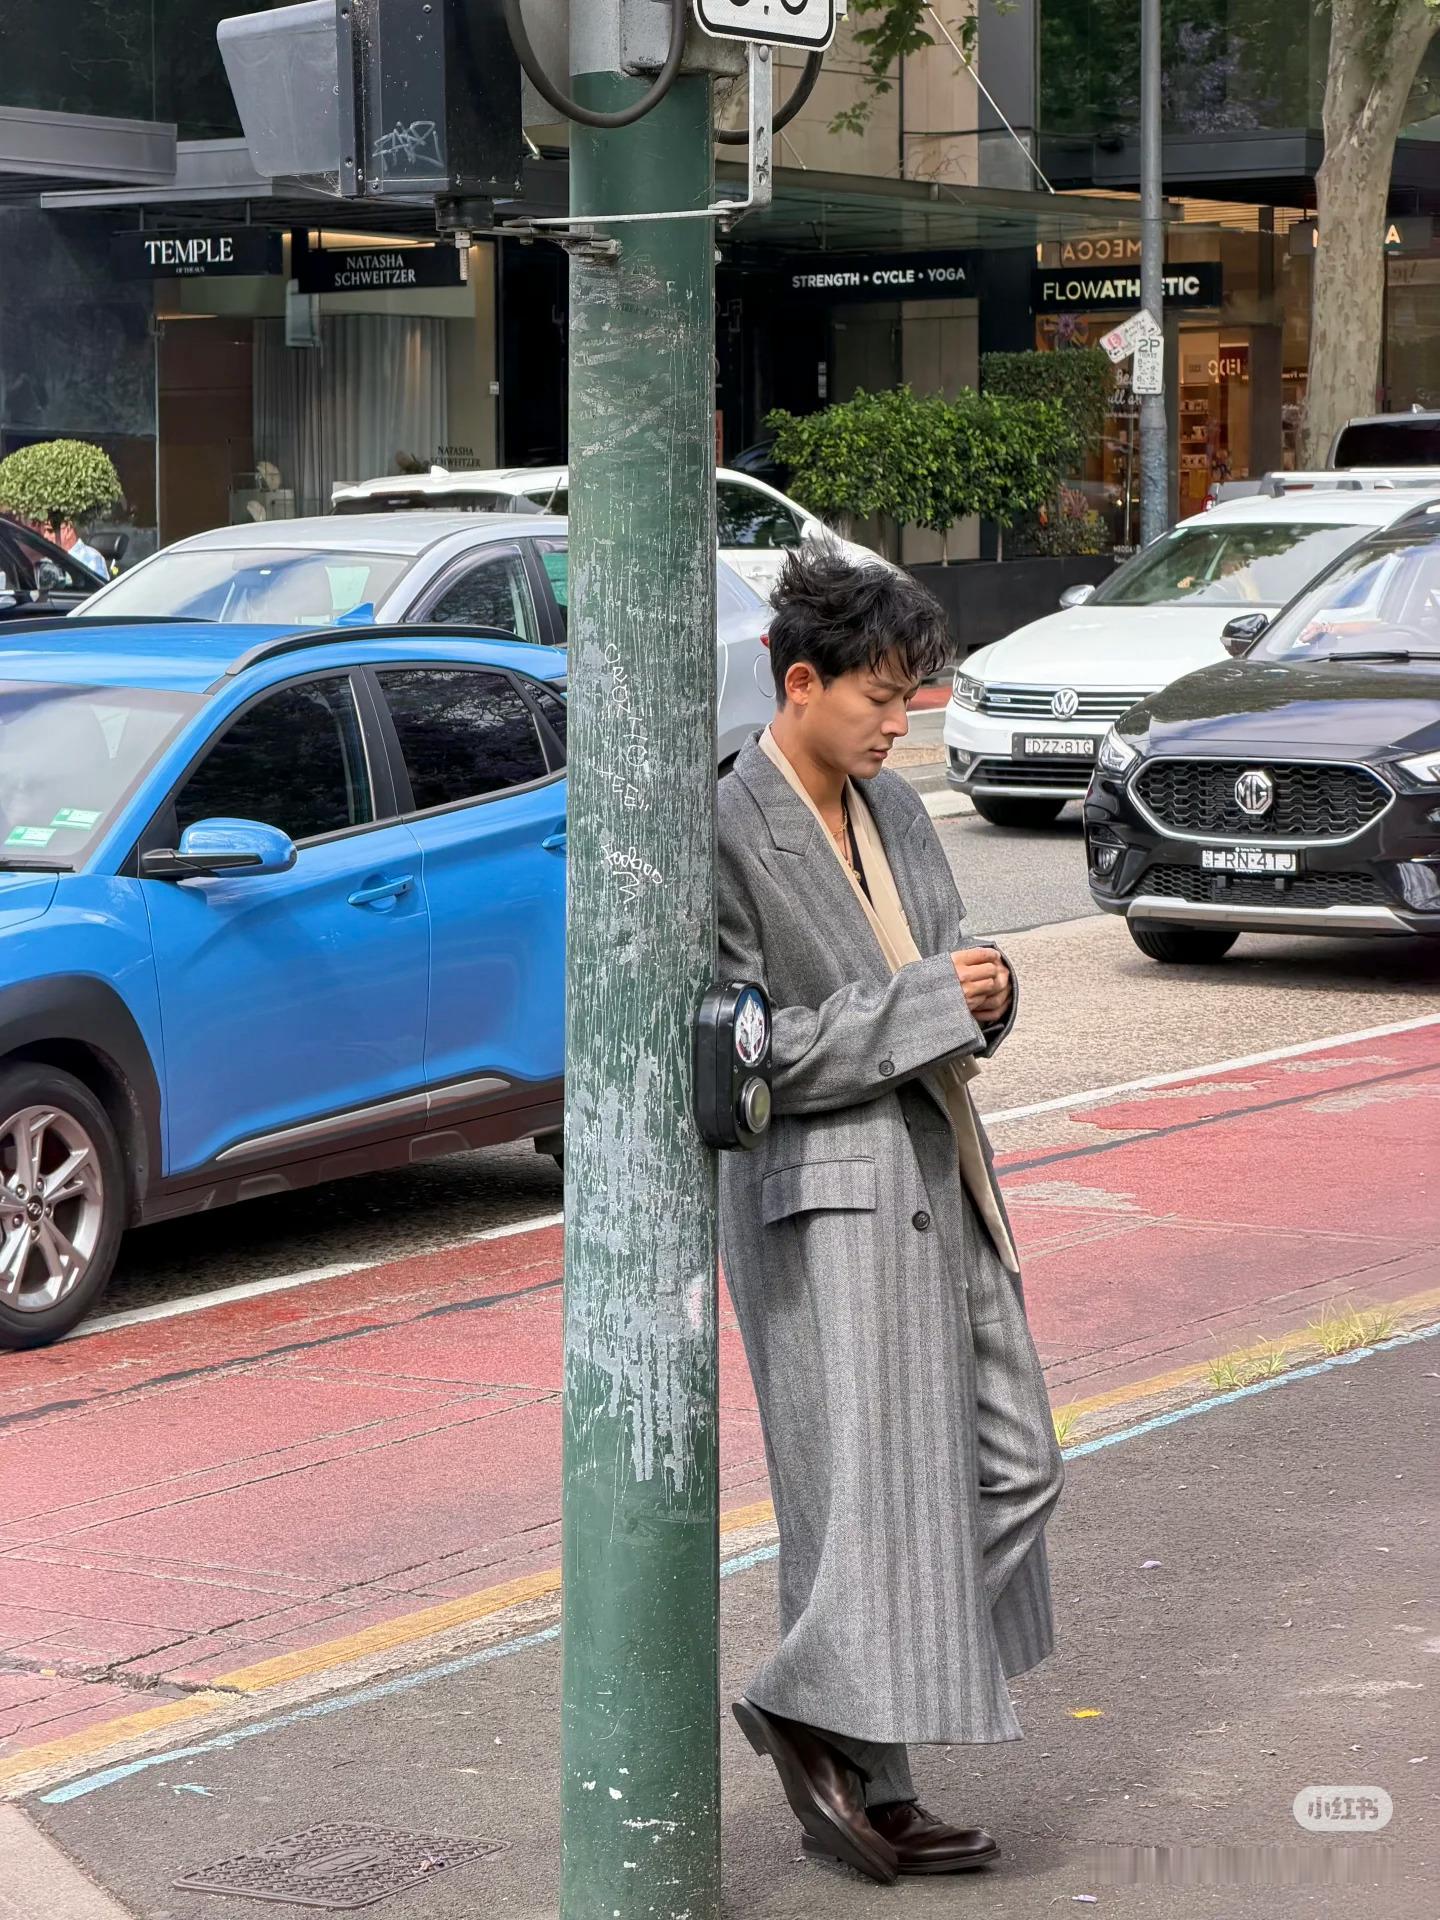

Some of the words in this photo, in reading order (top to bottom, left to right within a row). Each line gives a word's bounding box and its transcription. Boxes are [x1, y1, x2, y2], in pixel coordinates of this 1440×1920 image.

[144, 237, 234, 264] TEMPLE
[346, 254, 404, 270] NATASHA
[334, 268, 416, 287] SCHWEITZER
[792, 272, 860, 288] STRENGTH
[872, 269, 915, 285] CYCLE
[927, 267, 966, 282] YOGA
[1137, 338, 1160, 353] 2P
[437, 446, 474, 457] NATASHA
[1237, 775, 1268, 810] MG
